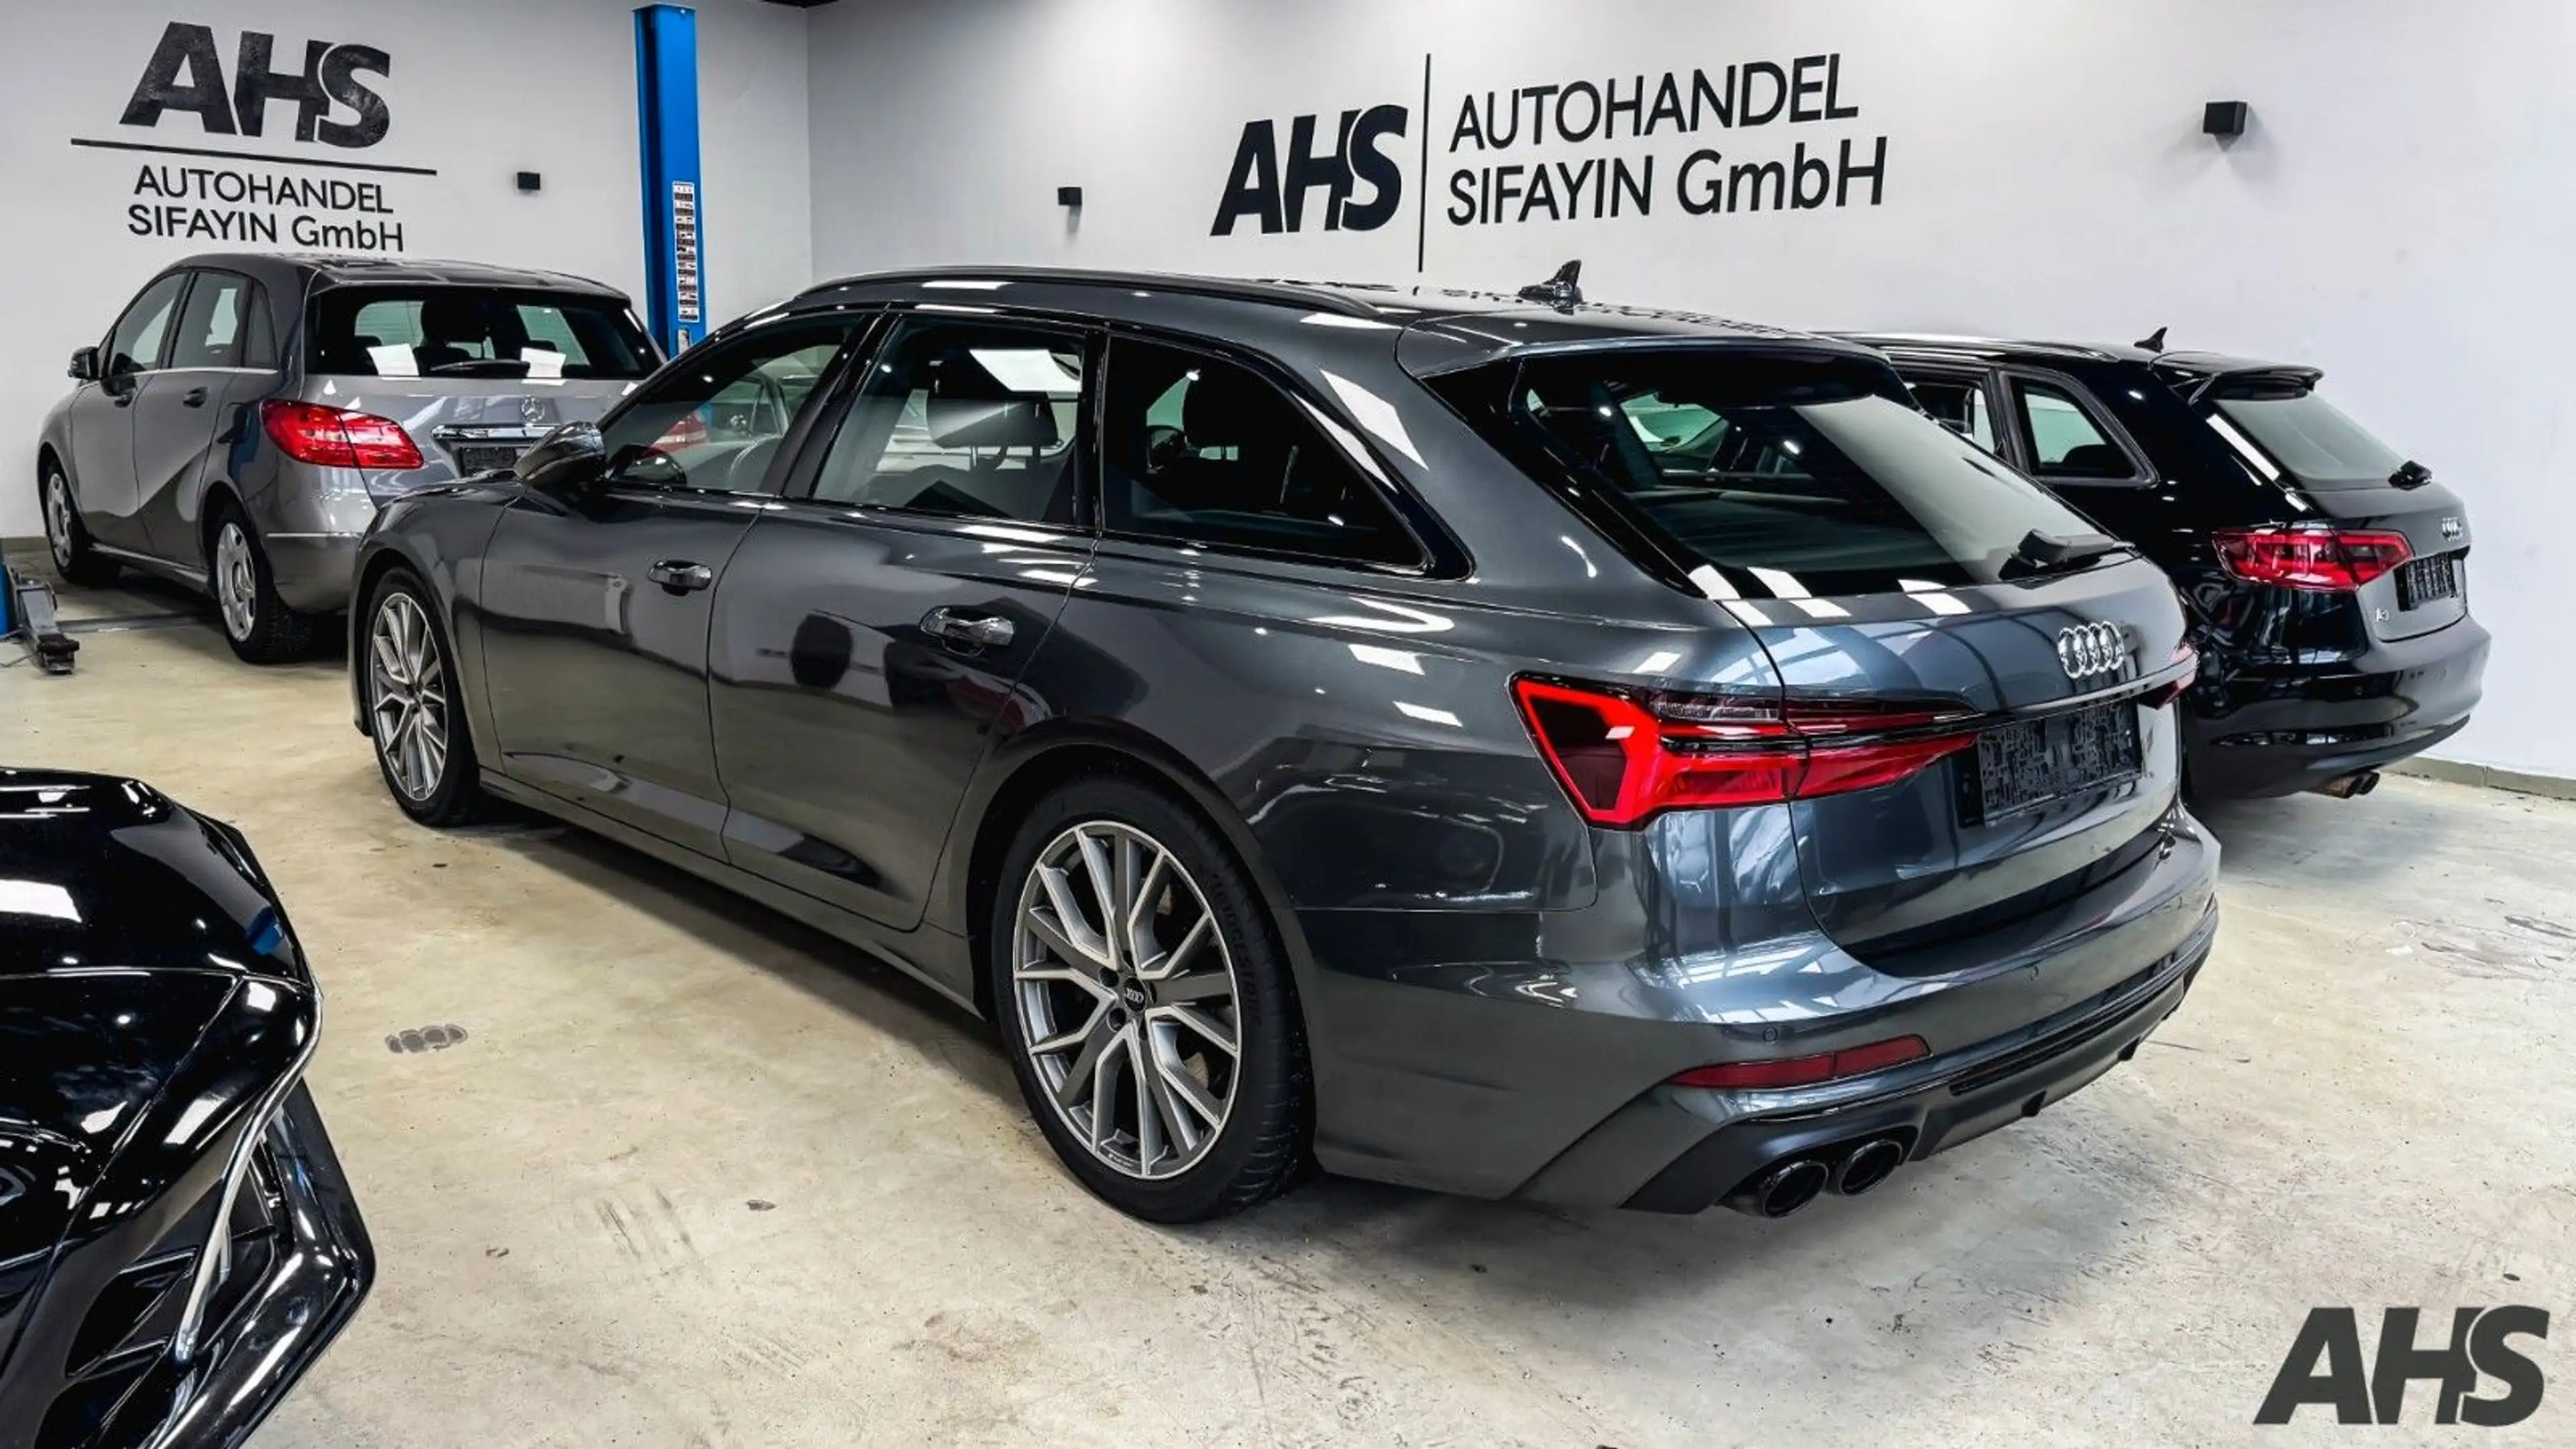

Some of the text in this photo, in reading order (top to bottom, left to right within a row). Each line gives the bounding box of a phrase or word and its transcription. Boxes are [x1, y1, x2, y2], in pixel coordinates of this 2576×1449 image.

[119, 21, 391, 149] AHS
[1448, 53, 1860, 153] AUTOHANDEL
[133, 164, 394, 214] AUTOHANDEL
[1210, 104, 1409, 237] AHS
[1447, 136, 1888, 227] SIFAYIN GmbH
[127, 203, 404, 252] SIFAYIN GmbH
